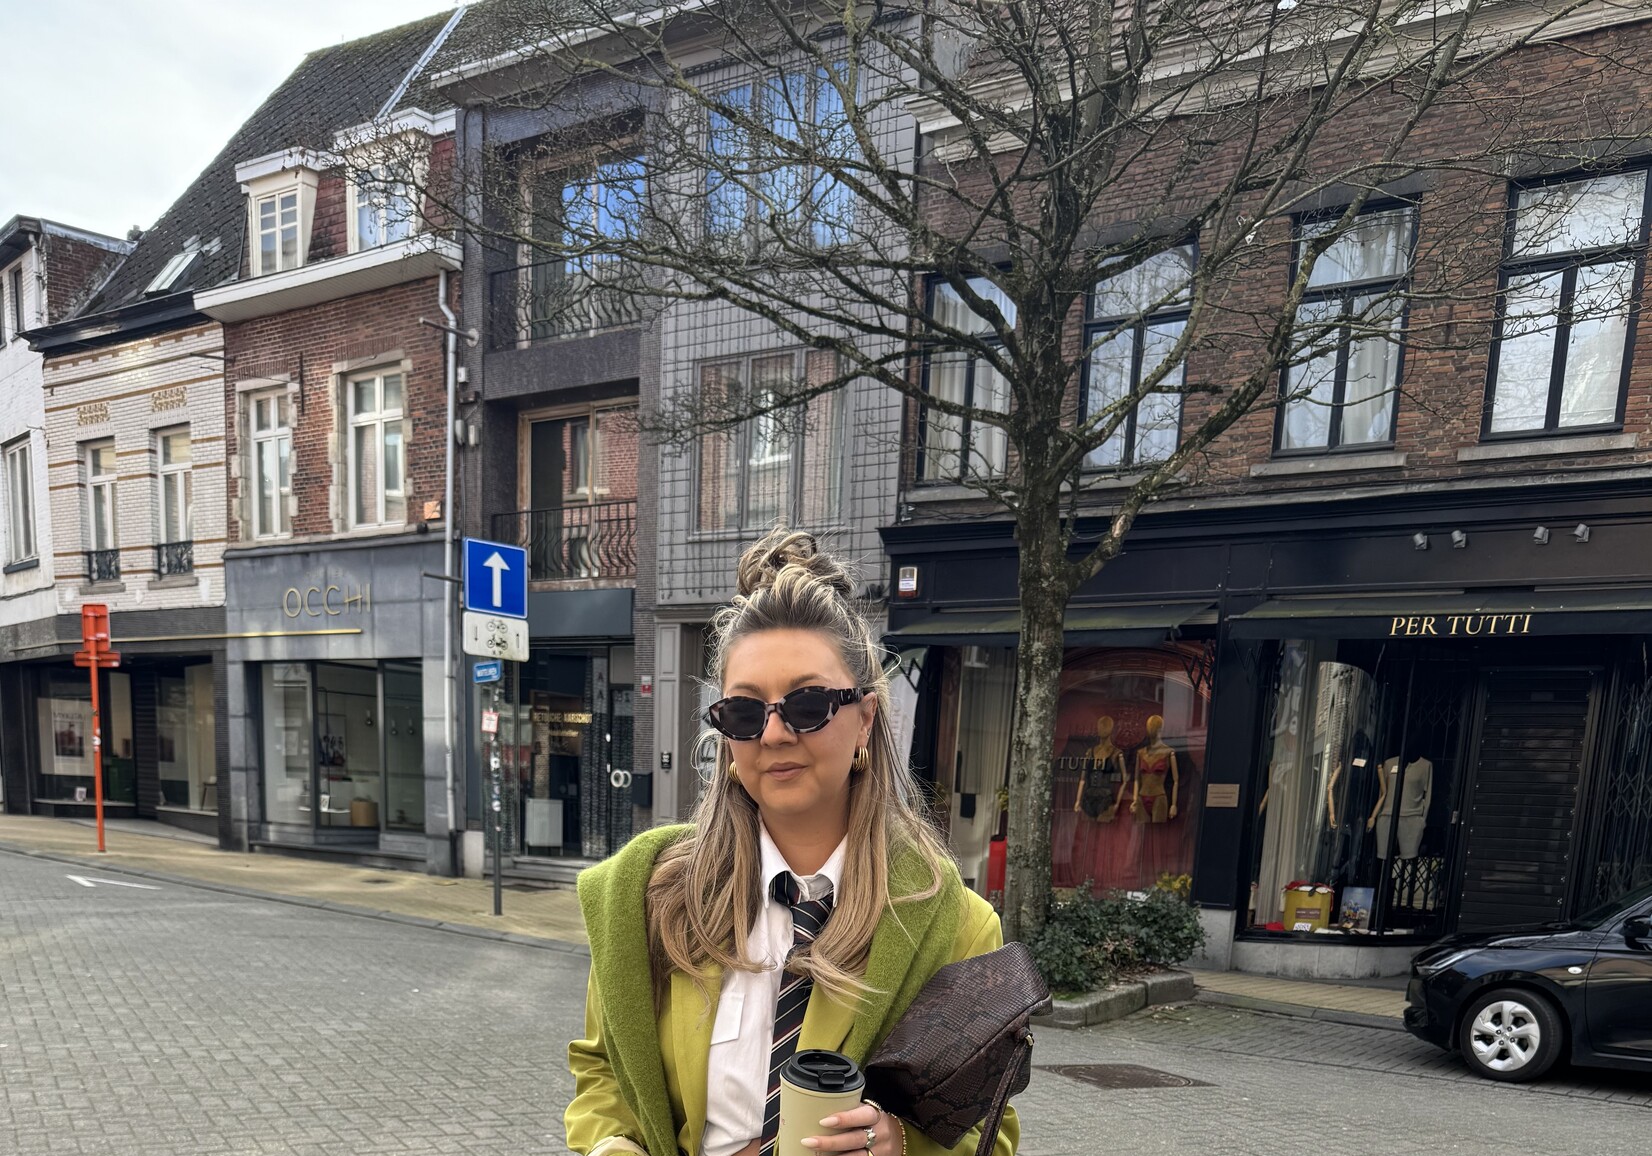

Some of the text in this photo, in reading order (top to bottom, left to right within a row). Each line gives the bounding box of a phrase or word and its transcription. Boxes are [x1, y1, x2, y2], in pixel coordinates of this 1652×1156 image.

[283, 583, 371, 618] OCCHI
[1389, 614, 1532, 636] PER TUTTI
[1057, 756, 1107, 771] TUTTI
